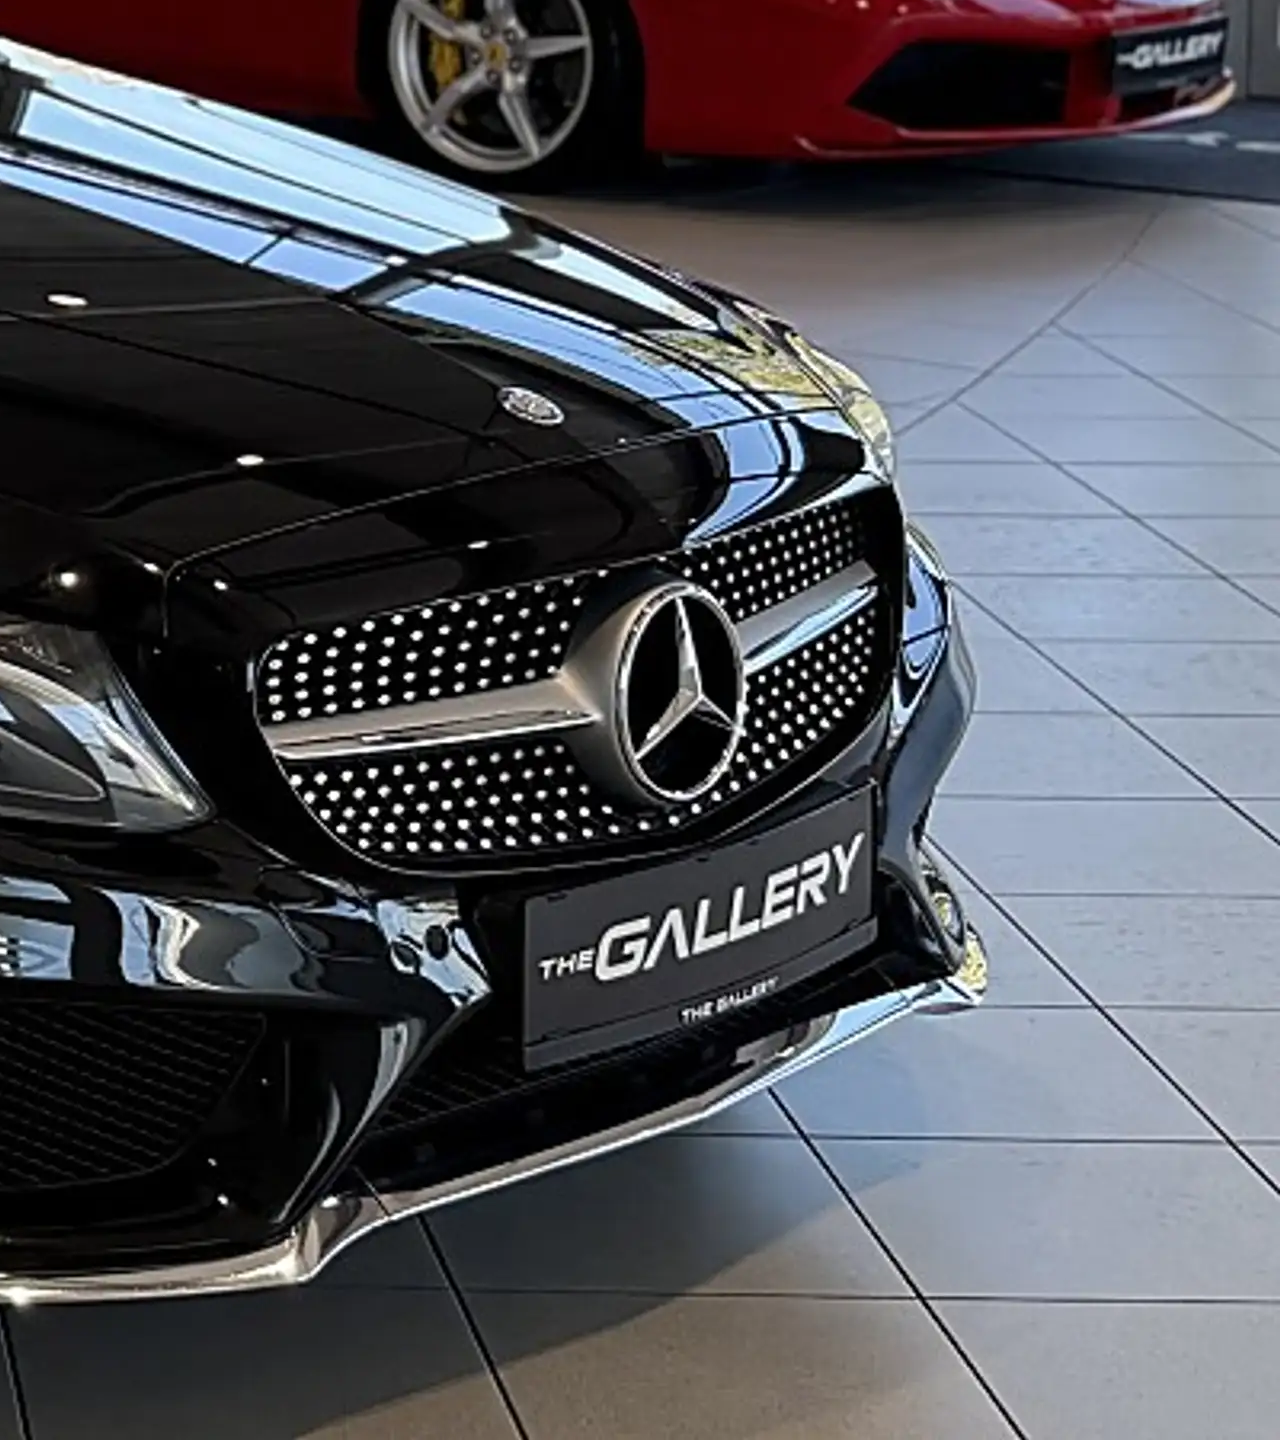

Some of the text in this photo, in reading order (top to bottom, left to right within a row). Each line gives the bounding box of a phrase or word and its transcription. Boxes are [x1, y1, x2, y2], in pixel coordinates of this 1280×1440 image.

[539, 832, 865, 981] THE GALLERY
[681, 976, 780, 1024] THE GALLERY
